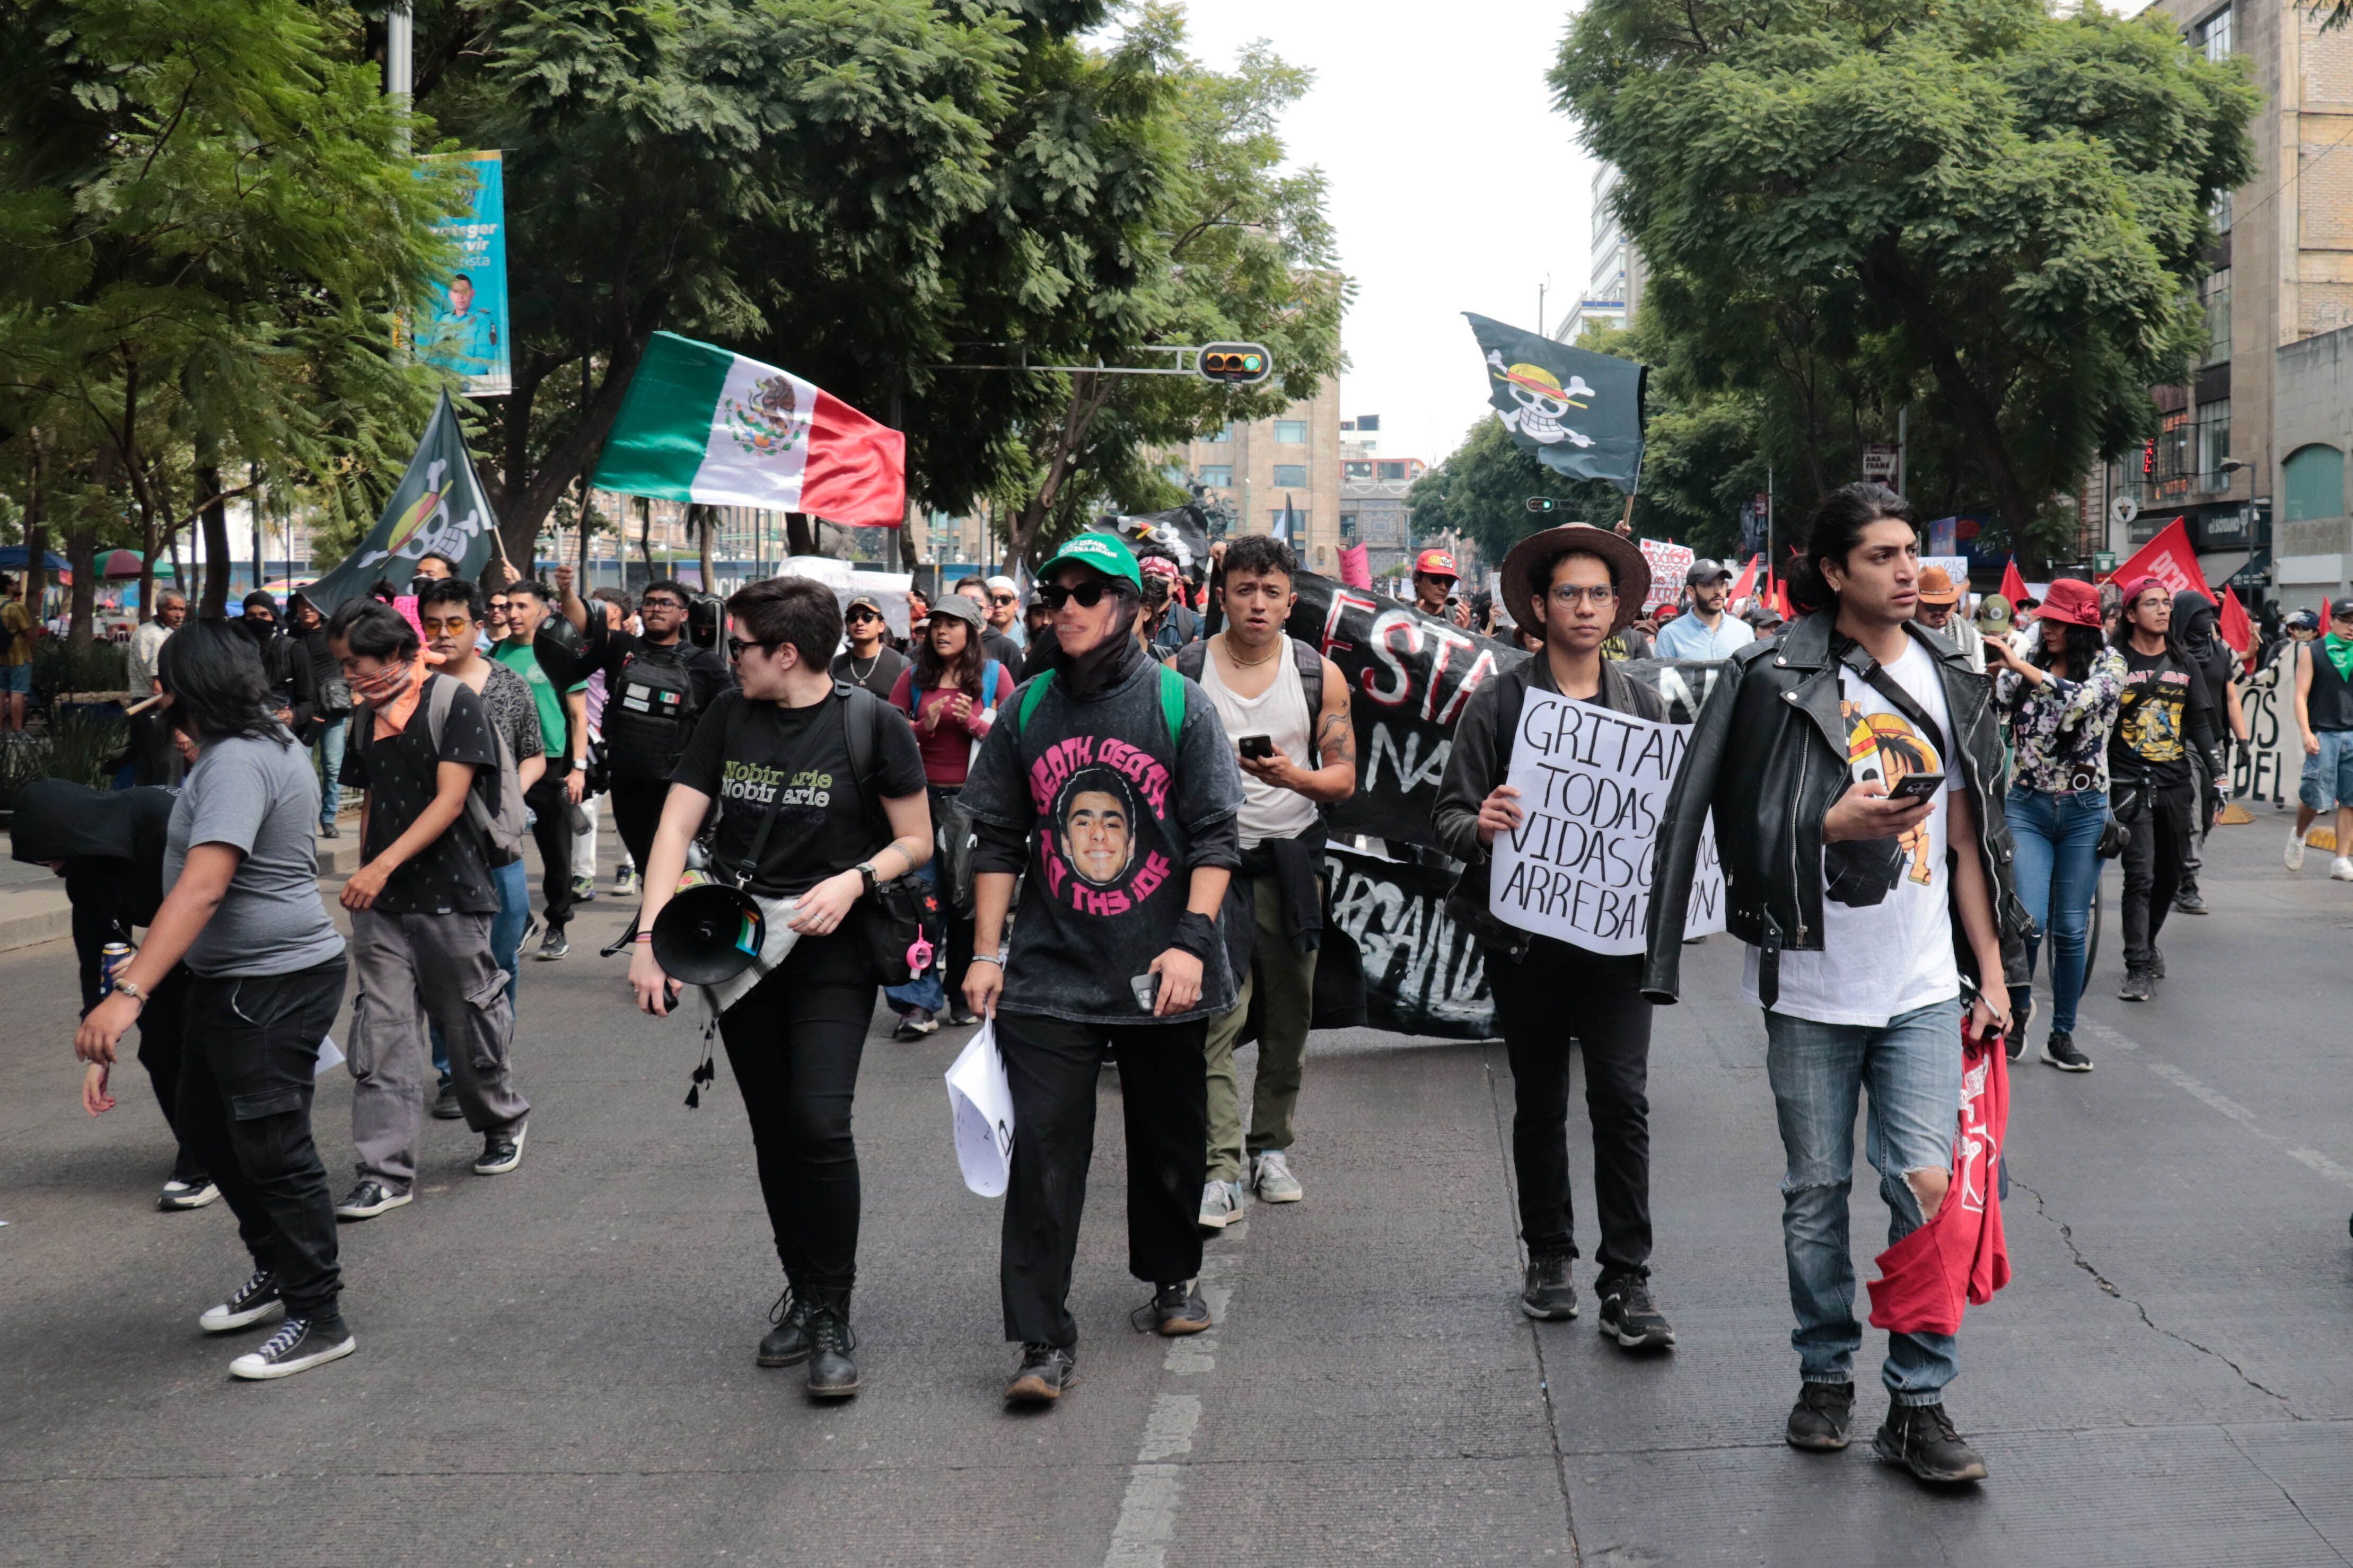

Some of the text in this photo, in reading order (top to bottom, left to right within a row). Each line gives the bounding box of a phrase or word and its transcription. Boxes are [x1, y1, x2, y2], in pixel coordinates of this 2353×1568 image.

[1537, 762, 1656, 839] TODAS
[2233, 751, 2285, 804] DEL
[1510, 812, 1634, 888] VIDAS
